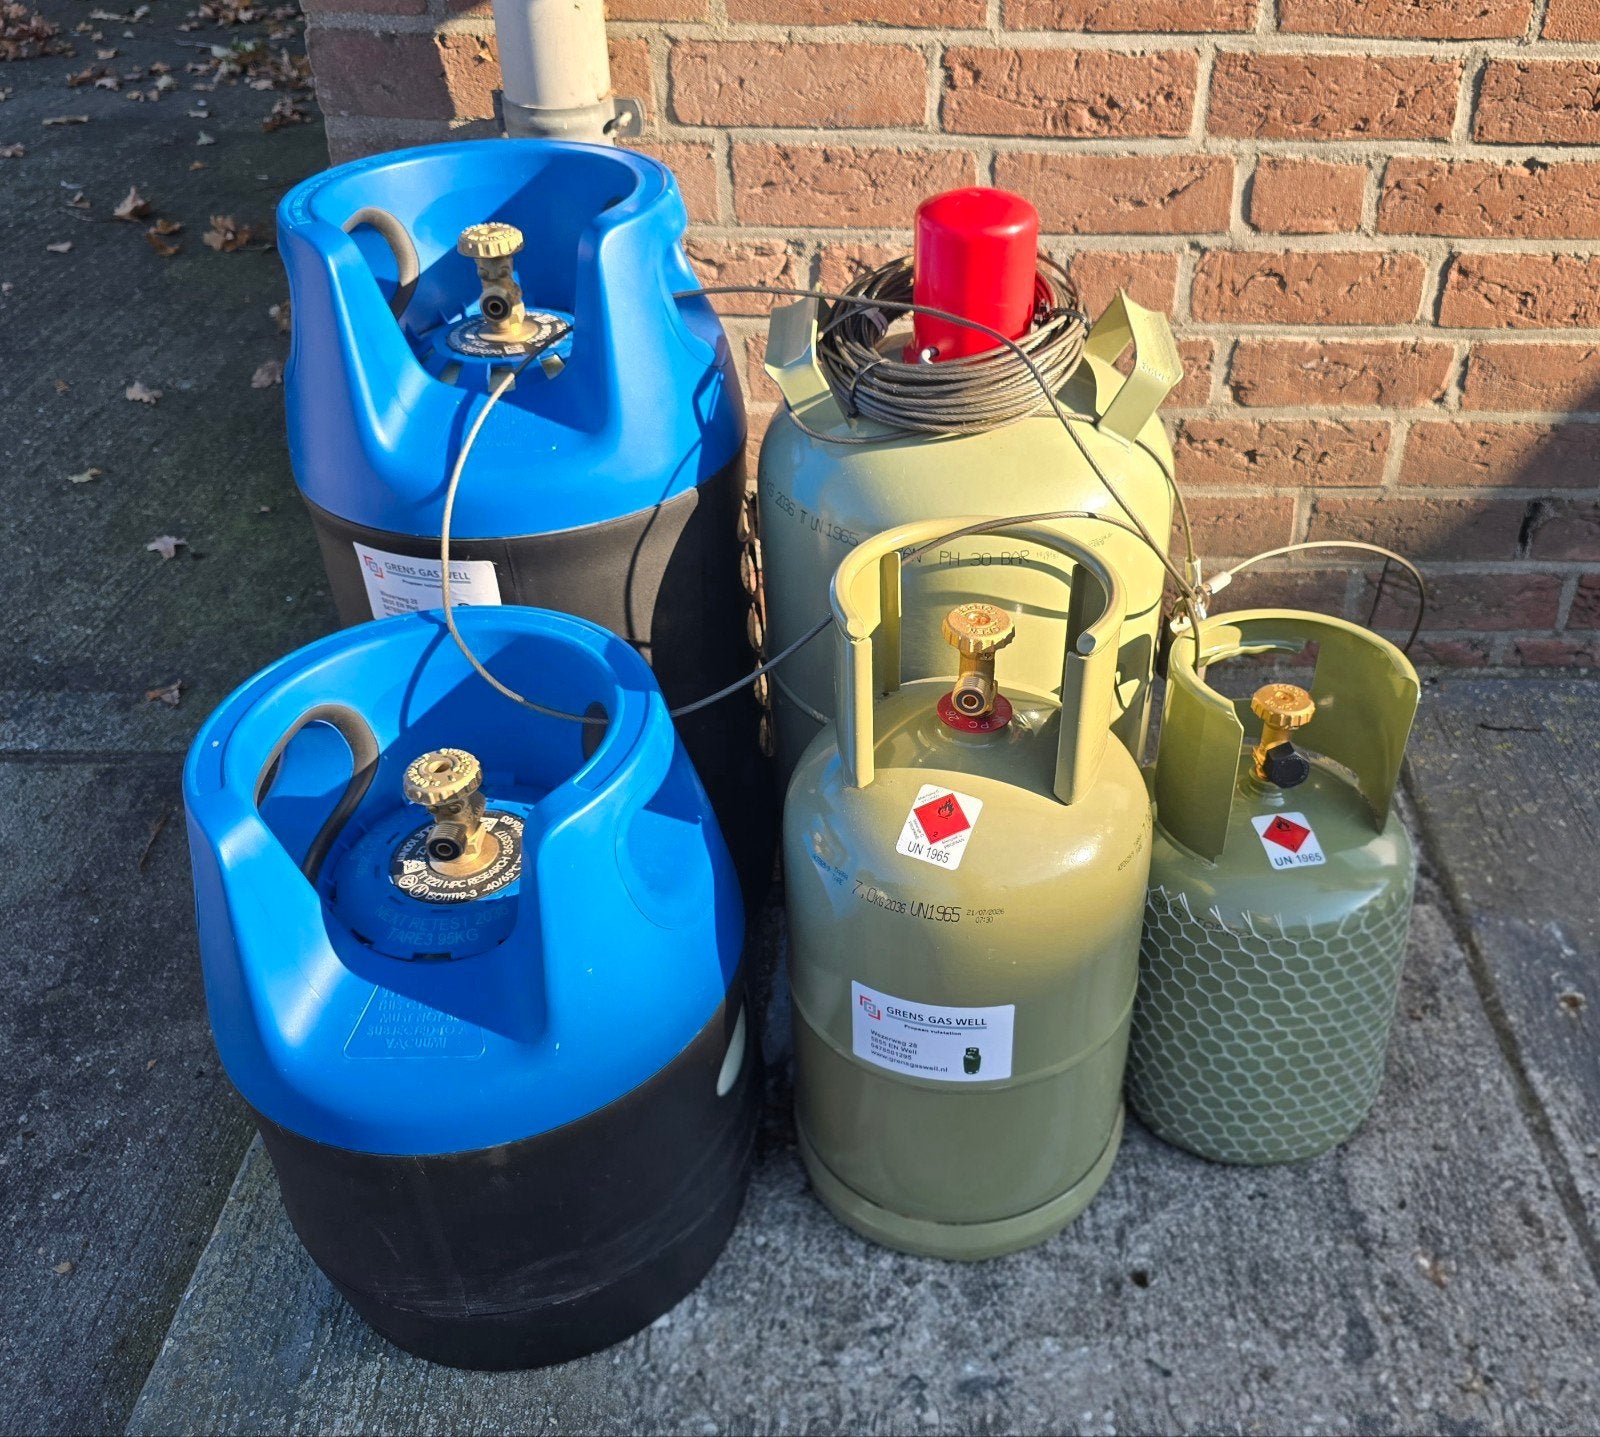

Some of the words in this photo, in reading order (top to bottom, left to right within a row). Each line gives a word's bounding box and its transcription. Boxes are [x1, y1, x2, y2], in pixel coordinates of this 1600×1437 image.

[810, 516, 825, 533] UN
[826, 523, 860, 547] 1965
[939, 550, 960, 566] PH
[970, 552, 991, 567] 30
[1000, 550, 1030, 566] BAR
[384, 561, 416, 576] GRENS
[418, 567, 440, 579] GAS
[907, 841, 925, 855] UN
[926, 847, 950, 863] 1965
[1274, 856, 1293, 866] UN
[1296, 852, 1322, 863] 1965
[443, 879, 467, 889] HPC
[467, 856, 511, 886] RESEARCH
[886, 1006, 924, 1022] GRENS
[928, 1015, 953, 1026] GAS
[955, 1018, 987, 1026] WELL
[870, 1029, 907, 1046] Wezerweg
[888, 1043, 900, 1052] EN
[900, 1046, 917, 1055] Well
